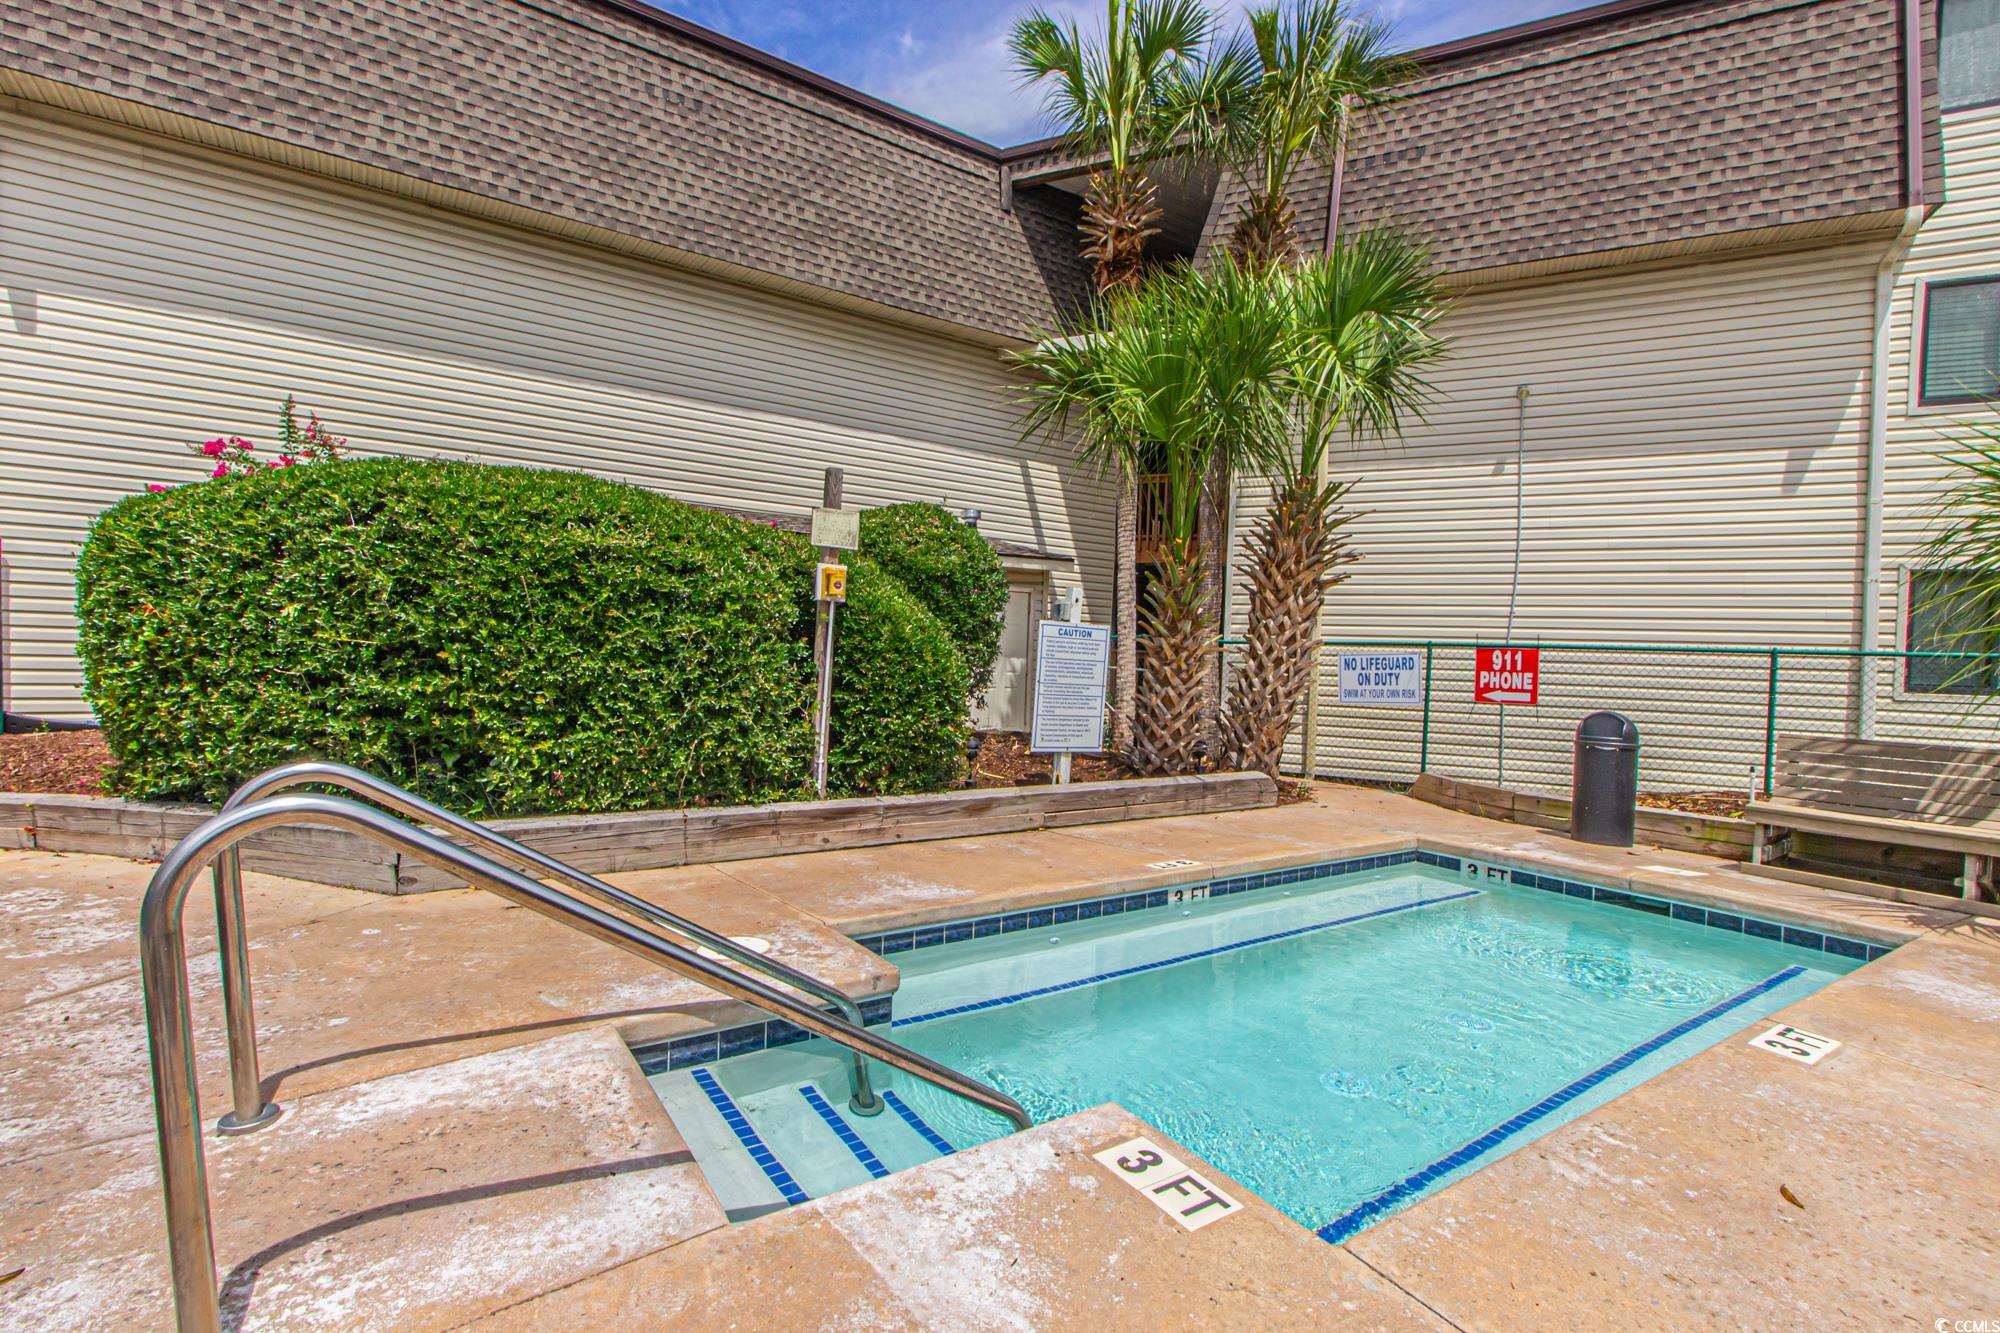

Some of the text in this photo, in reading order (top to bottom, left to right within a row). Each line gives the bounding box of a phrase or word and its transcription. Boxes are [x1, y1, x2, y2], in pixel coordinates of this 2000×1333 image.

[1058, 628, 1093, 638] CAUTION
[1344, 656, 1415, 671] NO LIFEGUARD
[1492, 649, 1523, 671] 911
[1357, 672, 1400, 686] ON DUTY
[1480, 671, 1533, 690] PHONE
[1343, 688, 1416, 698] SWIM AT YOUR OWN RISK
[1467, 863, 1509, 881] 3 FT
[1174, 885, 1208, 903] 3 FT
[1764, 1027, 1830, 1057] 3 FT
[1116, 1149, 1232, 1217] 3 FT
